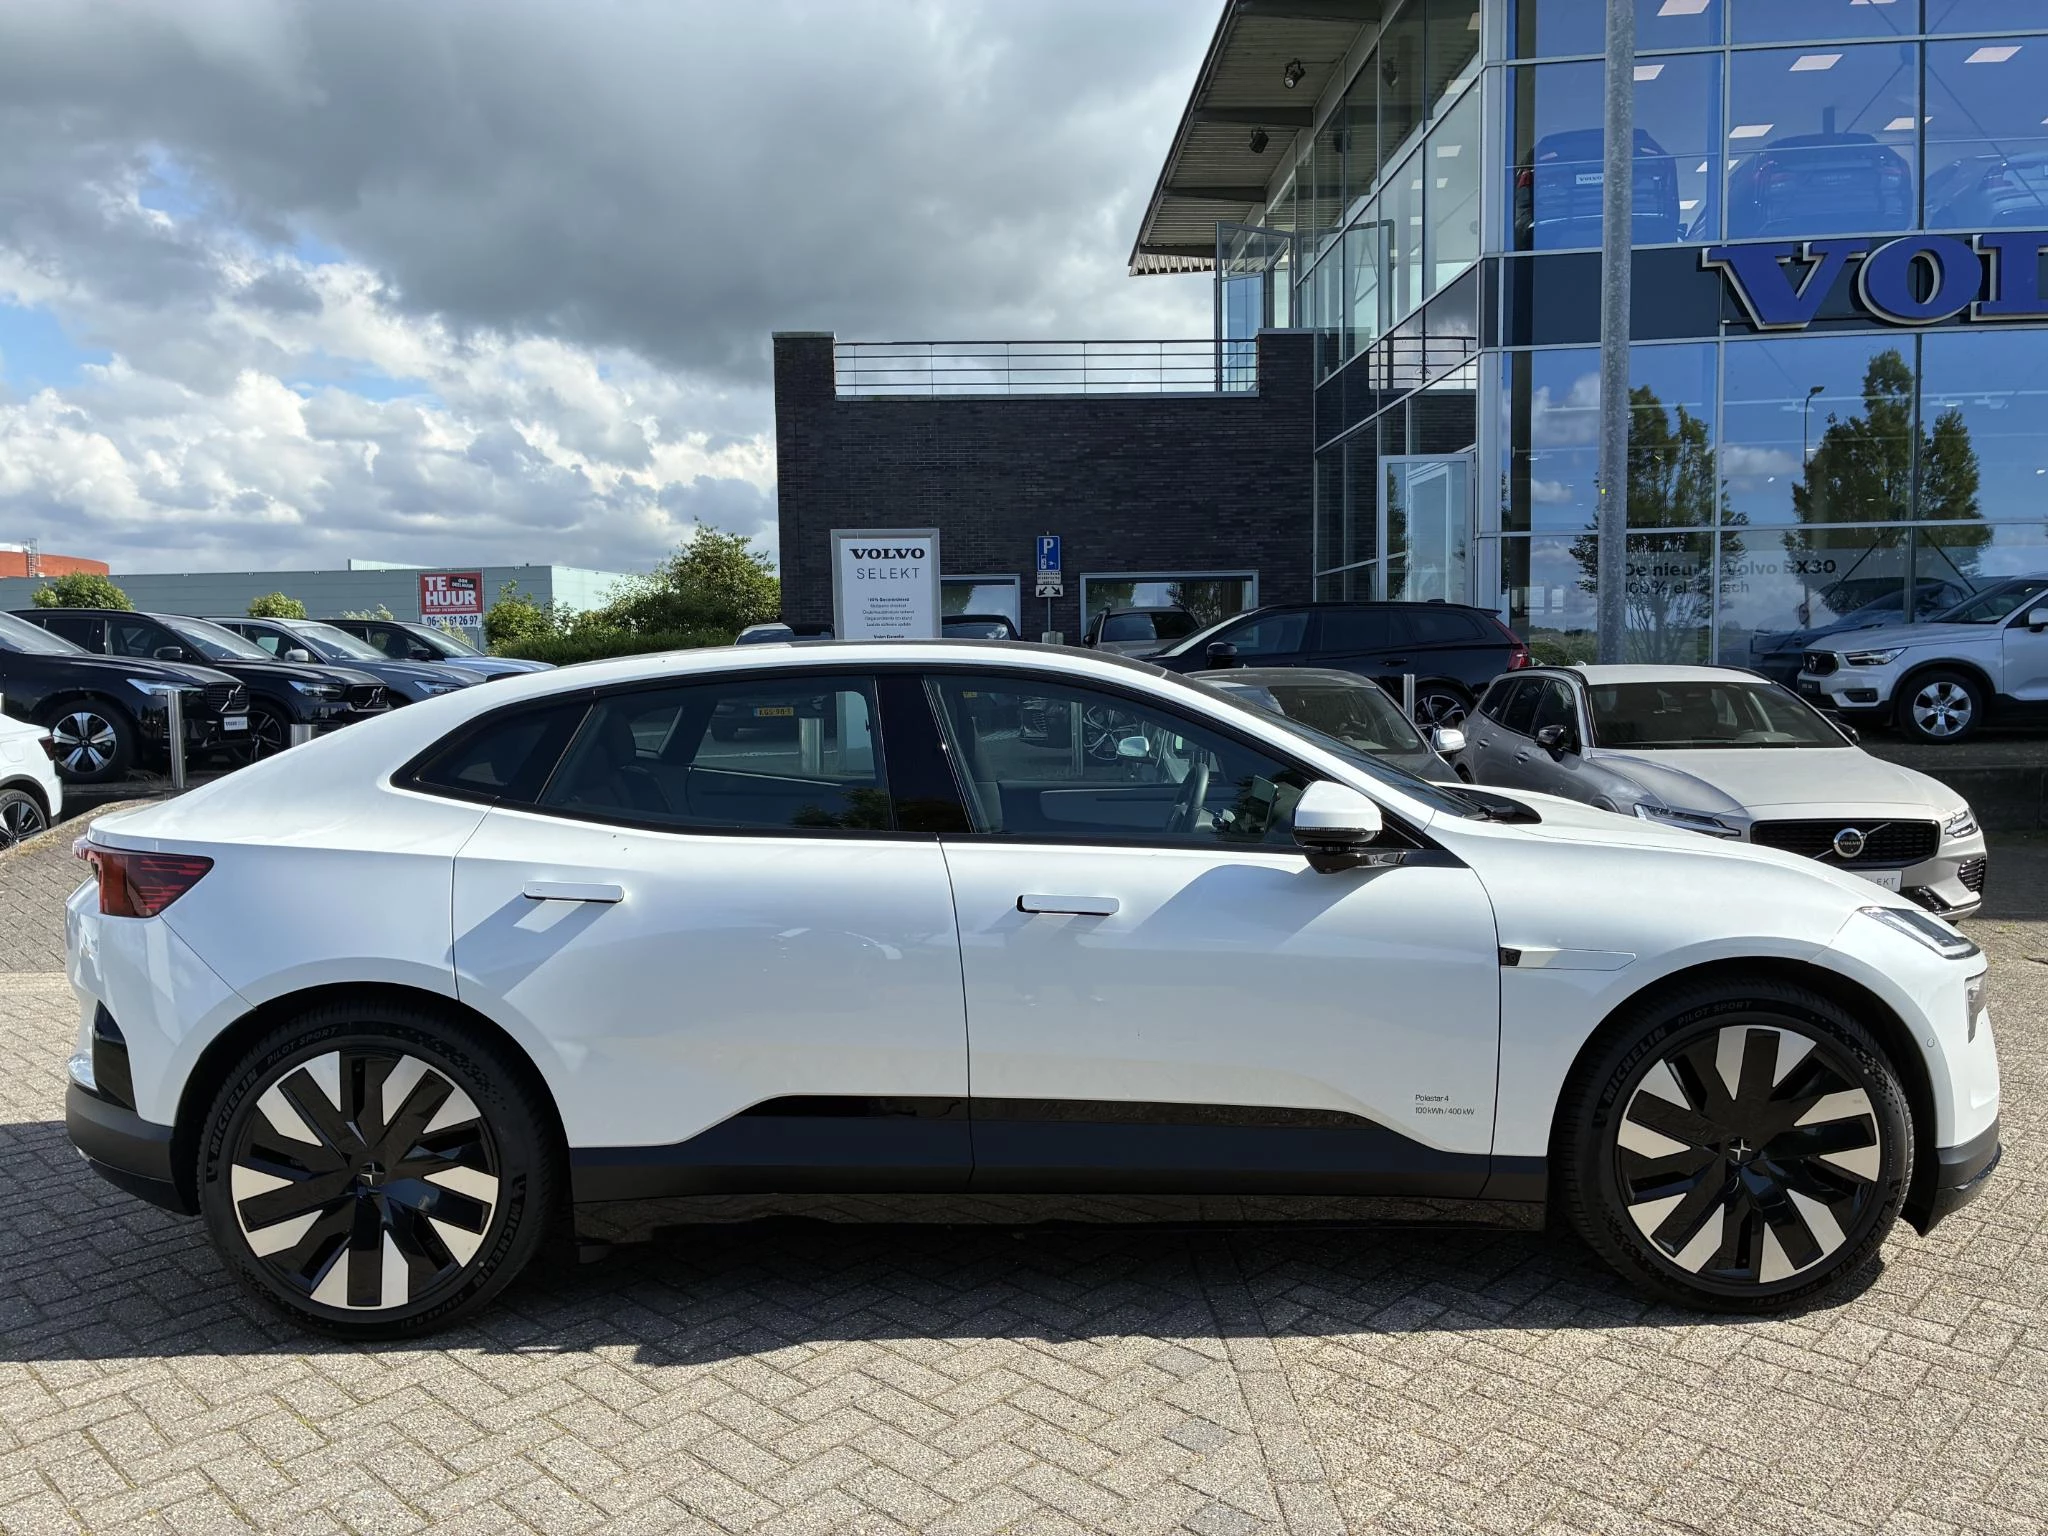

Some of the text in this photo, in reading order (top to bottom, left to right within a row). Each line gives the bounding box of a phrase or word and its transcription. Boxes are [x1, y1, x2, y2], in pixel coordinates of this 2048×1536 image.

[849, 548, 925, 560] VOLVO
[856, 567, 920, 580] SELEKT
[425, 576, 447, 591] TE
[425, 590, 477, 606] HUUR
[459, 615, 468, 625] 26
[469, 615, 478, 625] 97
[1603, 1000, 1752, 1103] MICHELIN PILOT SPORT
[209, 1027, 338, 1155] MICHELIN PILOT SPORT
[1415, 1094, 1444, 1102] Polestar
